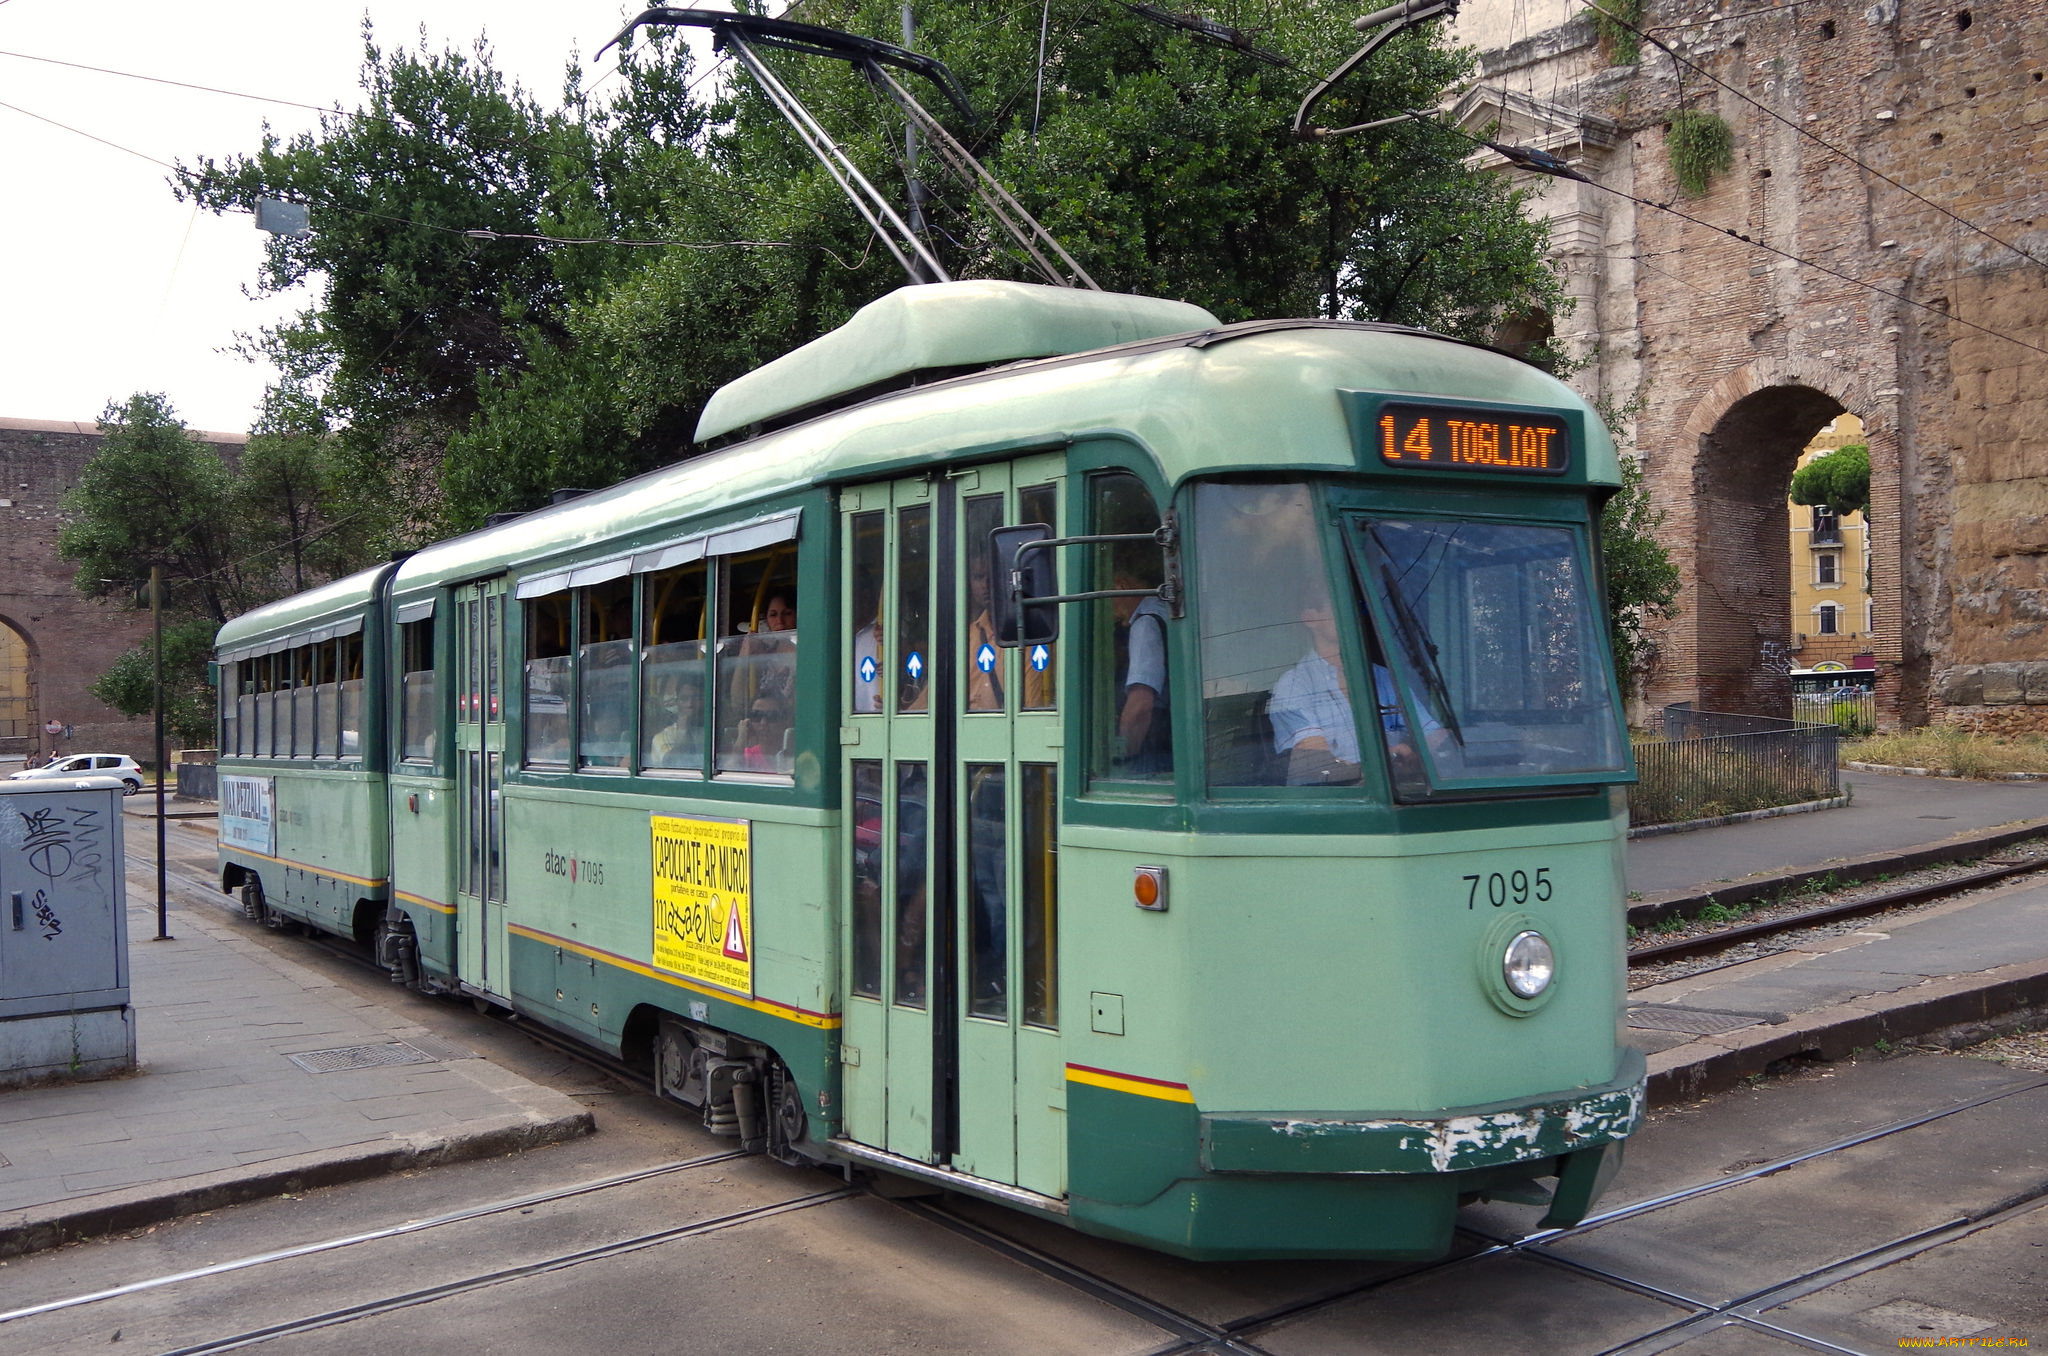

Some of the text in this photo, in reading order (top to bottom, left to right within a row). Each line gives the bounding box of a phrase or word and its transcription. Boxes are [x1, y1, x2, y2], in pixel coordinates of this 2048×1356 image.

[1380, 415, 1558, 468] 14 TOGLIAT
[545, 847, 604, 885] atac 7095
[655, 835, 748, 895] CAPOCCIATE AR MURO!
[1463, 867, 1553, 910] 7095
